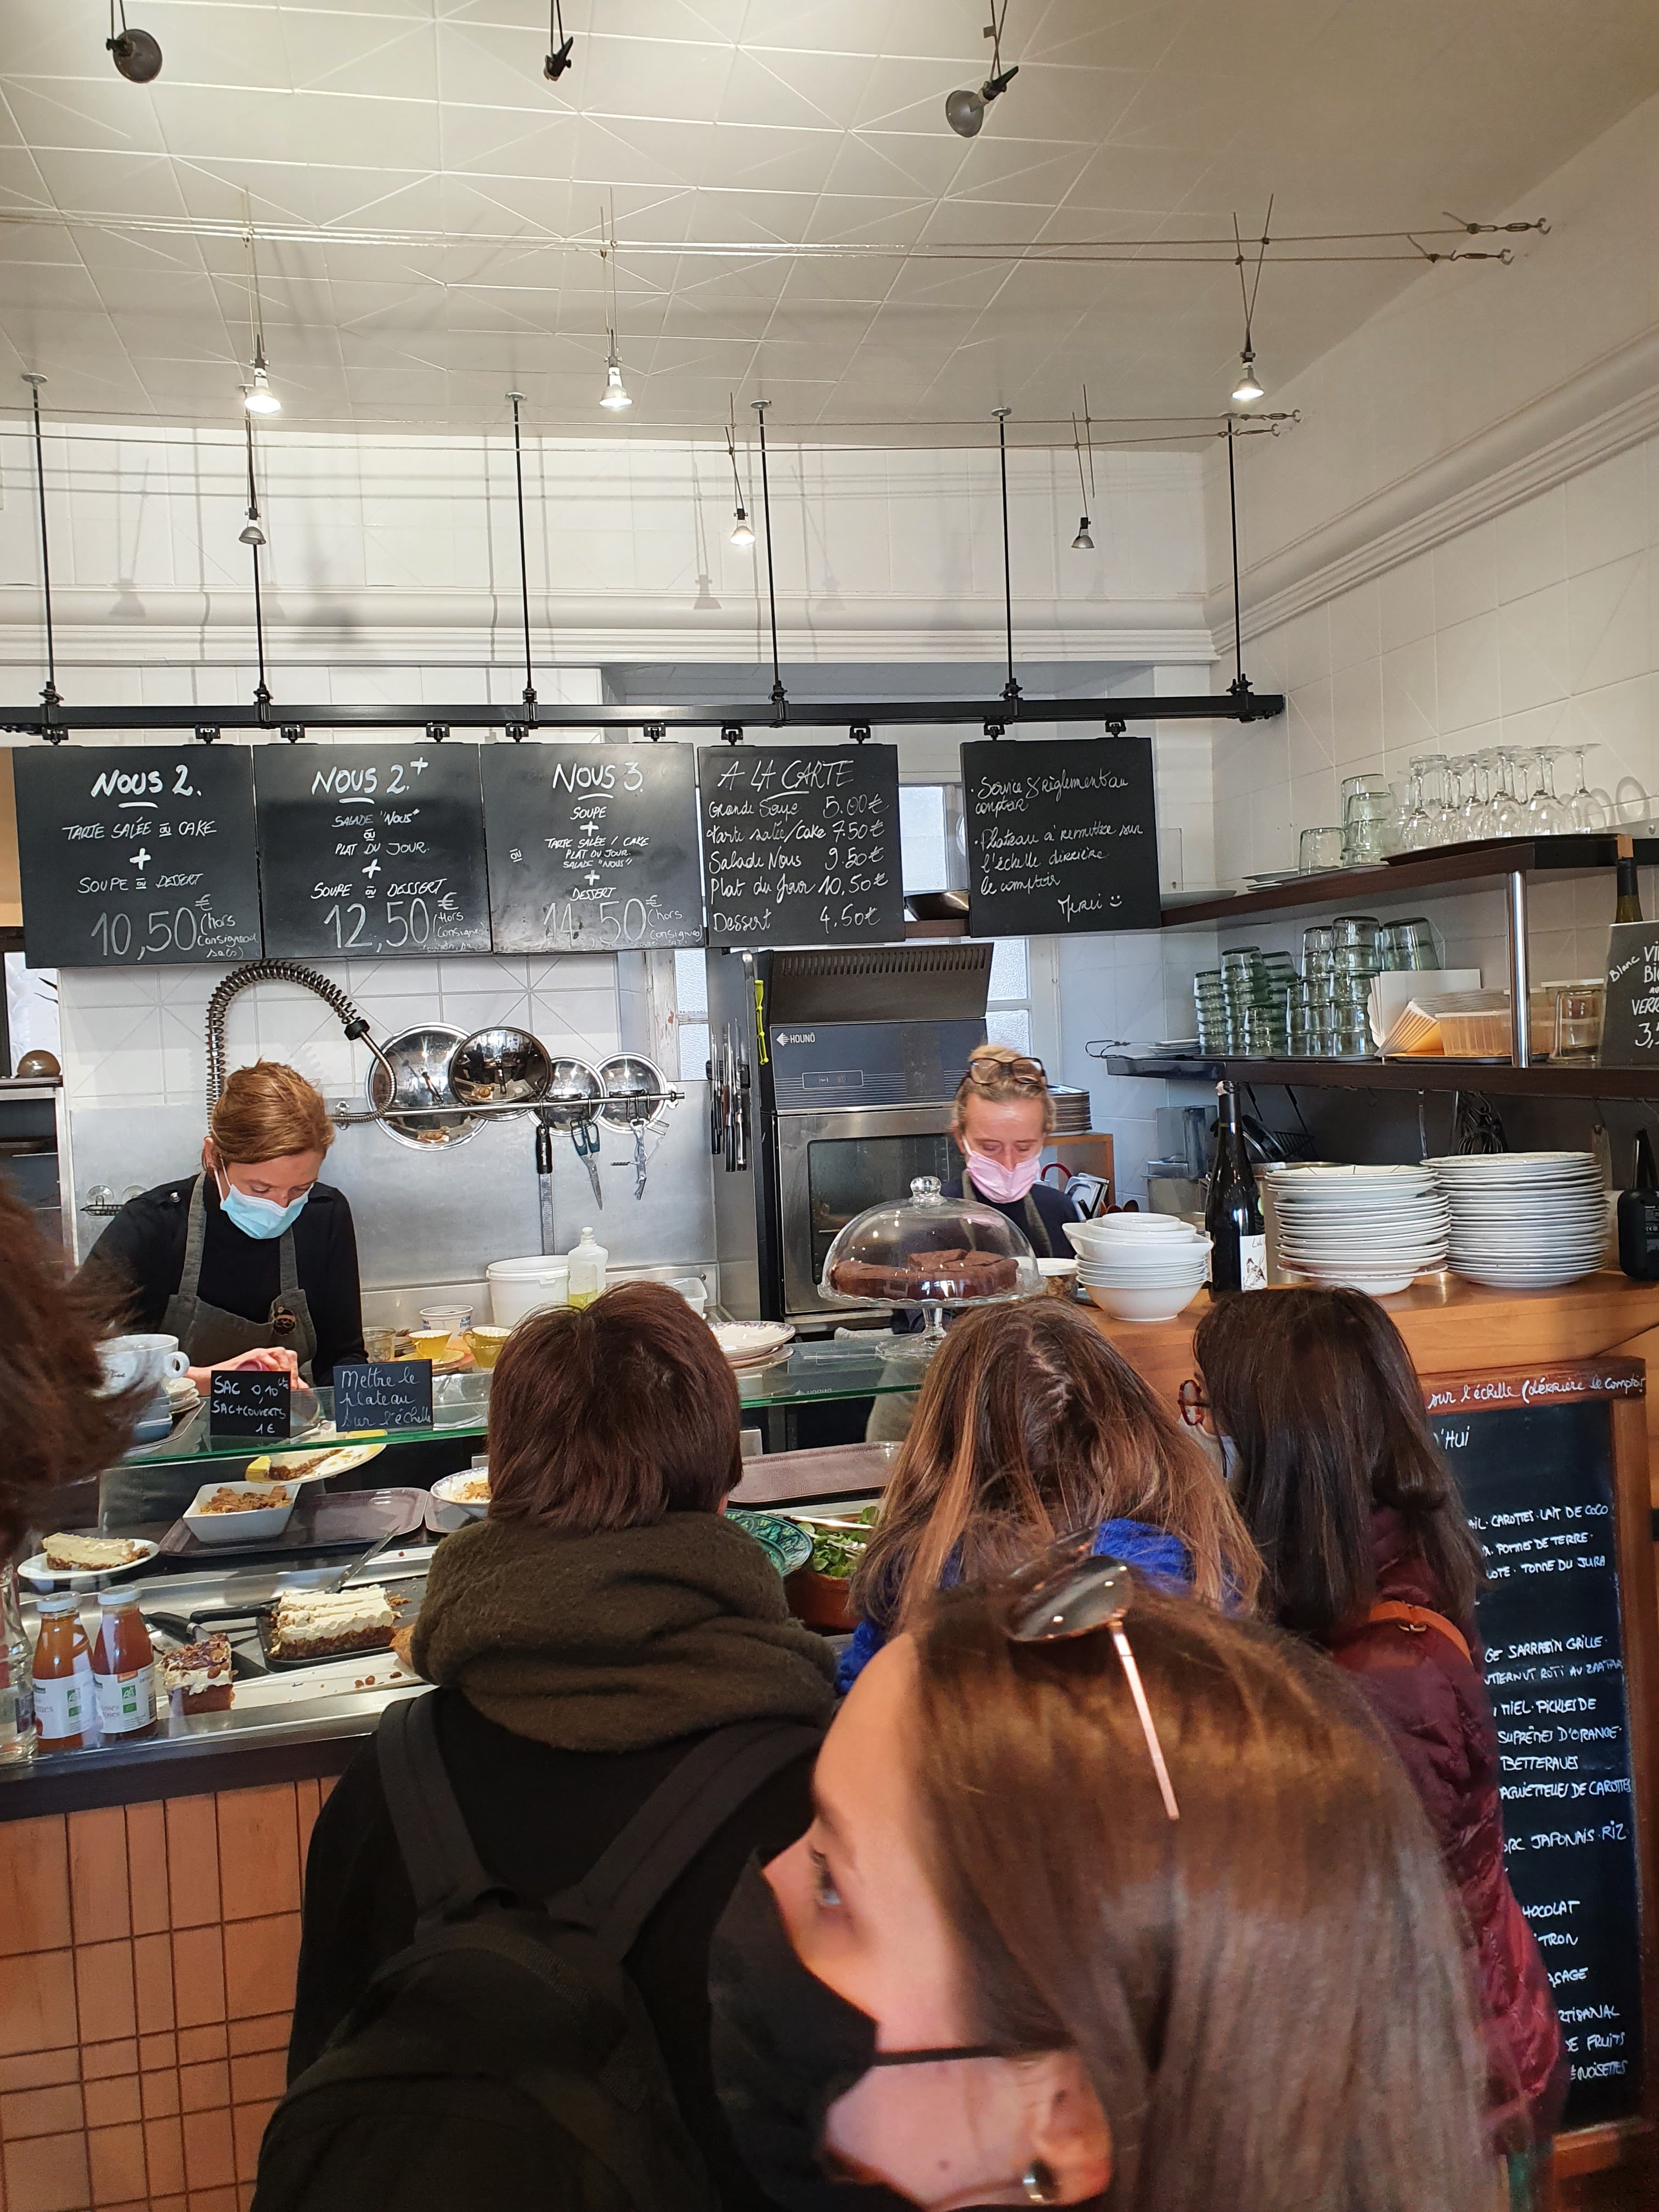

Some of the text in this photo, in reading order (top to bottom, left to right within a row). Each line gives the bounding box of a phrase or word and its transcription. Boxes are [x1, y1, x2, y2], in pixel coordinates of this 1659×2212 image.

[91, 769, 163, 797] NOUS
[311, 766, 377, 795] NOUS
[552, 763, 616, 793] NOUS
[717, 760, 854, 792] A LA CARTE
[978, 776, 1023, 799] Service
[331, 814, 374, 827] SALADE
[570, 806, 607, 820] SOUPE
[709, 800, 754, 818] Grande
[759, 800, 798, 822] Soupe
[61, 825, 105, 840] TARTE
[111, 816, 152, 839] SALÉE
[178, 820, 217, 837] CAKE
[1060, 821, 1116, 841] remettre
[1119, 824, 1143, 837] sur
[335, 843, 358, 856] PLAT
[364, 843, 381, 854] DU
[545, 838, 573, 849] TARTE
[578, 836, 606, 848] SALÉE
[623, 836, 650, 846] CAKE
[563, 861, 593, 869] SALADE
[566, 850, 588, 859] PLAT
[709, 851, 764, 874] Salade
[768, 846, 802, 870] Nous
[981, 851, 1041, 873] l'échelle
[77, 877, 129, 894] SOUPE
[155, 873, 204, 888] DESSERT
[311, 882, 352, 899] SOUPE
[387, 878, 447, 897] DESSERT
[569, 887, 616, 901] DESSERT
[711, 878, 746, 905] Plat
[753, 876, 771, 894] du
[980, 872, 1061, 895] le comptoir
[1057, 893, 1103, 923] Merci
[713, 909, 771, 932] Dessert
[1644, 941, 1659, 962] VI
[1609, 956, 1640, 982] Blanc
[1632, 997, 1659, 1016] VERR
[214, 1375, 240, 1395] SAC
[342, 1366, 420, 1391] Mettre le
[1427, 1391, 1456, 1409] sur
[1460, 1382, 1521, 1402] l'échelle
[1589, 1374, 1603, 1390] le
[339, 1390, 416, 1416] plateau
[341, 1406, 431, 1427] sur l'échelle
[1491, 1510, 1534, 1527] CAROTTES
[1565, 1506, 1583, 1519] DE
[1585, 1504, 1609, 1516] COCO
[1496, 1540, 1533, 1555] POMMES
[1534, 1537, 1549, 1550] DE
[1550, 1532, 1589, 1545] TERRE
[1558, 1558, 1573, 1571] DU
[1577, 1555, 1605, 1568] JURA
[1485, 1648, 1503, 1663] GE
[1508, 1639, 1562, 1658] SARRASIN
[1483, 1668, 1537, 1685] UTTERNUT
[1541, 1666, 1564, 1680] ROTI
[1570, 1666, 1583, 1677] AU
[1500, 1700, 1531, 1716] MIEL
[1577, 1697, 1597, 1711] DE
[1500, 1755, 1578, 1771] BETTERAVES
[1571, 1782, 1587, 1798] DE
[1589, 1778, 1631, 1796] CAROTTES
[1531, 1828, 1595, 1849] JAPONAIS
[1602, 1820, 1626, 1840] RIZ
[1522, 1900, 1581, 1918] HOCOLAT
[1558, 2004, 1620, 2023] RTISANAL
[1587, 2032, 1625, 2051] FRUITS
